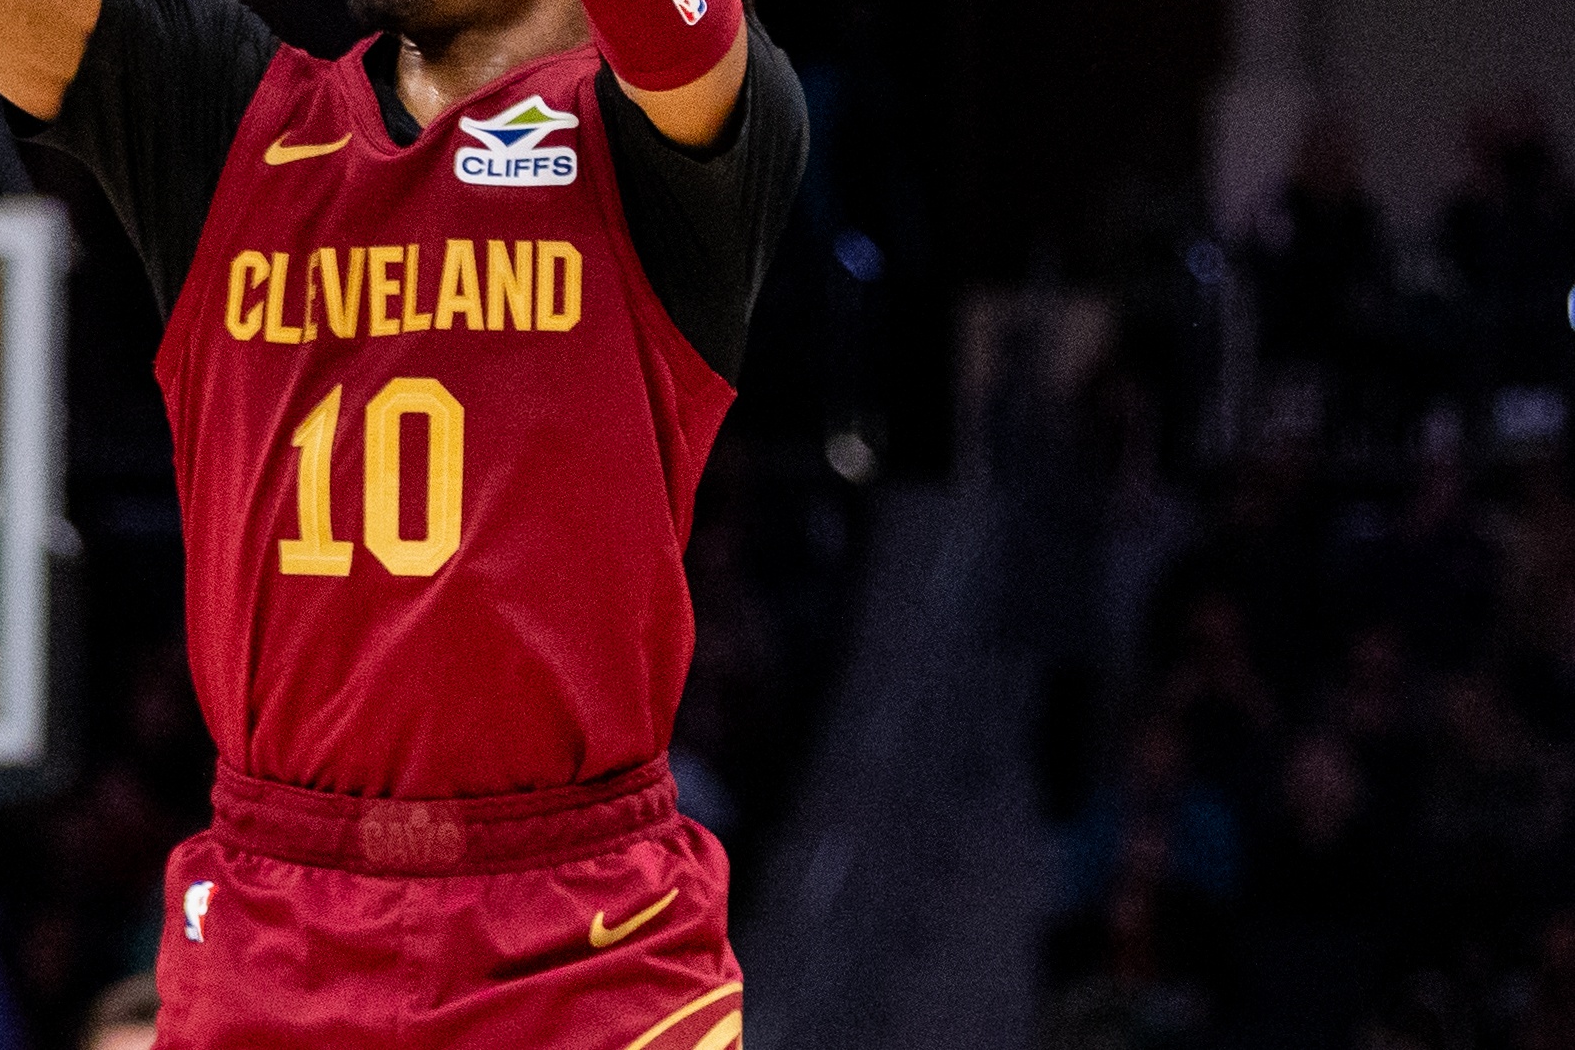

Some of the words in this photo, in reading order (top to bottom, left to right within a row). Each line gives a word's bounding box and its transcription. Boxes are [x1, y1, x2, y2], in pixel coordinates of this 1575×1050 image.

[462, 155, 573, 177] CLIFFS
[226, 240, 582, 345] CLEVELAND
[279, 377, 464, 577] 10
